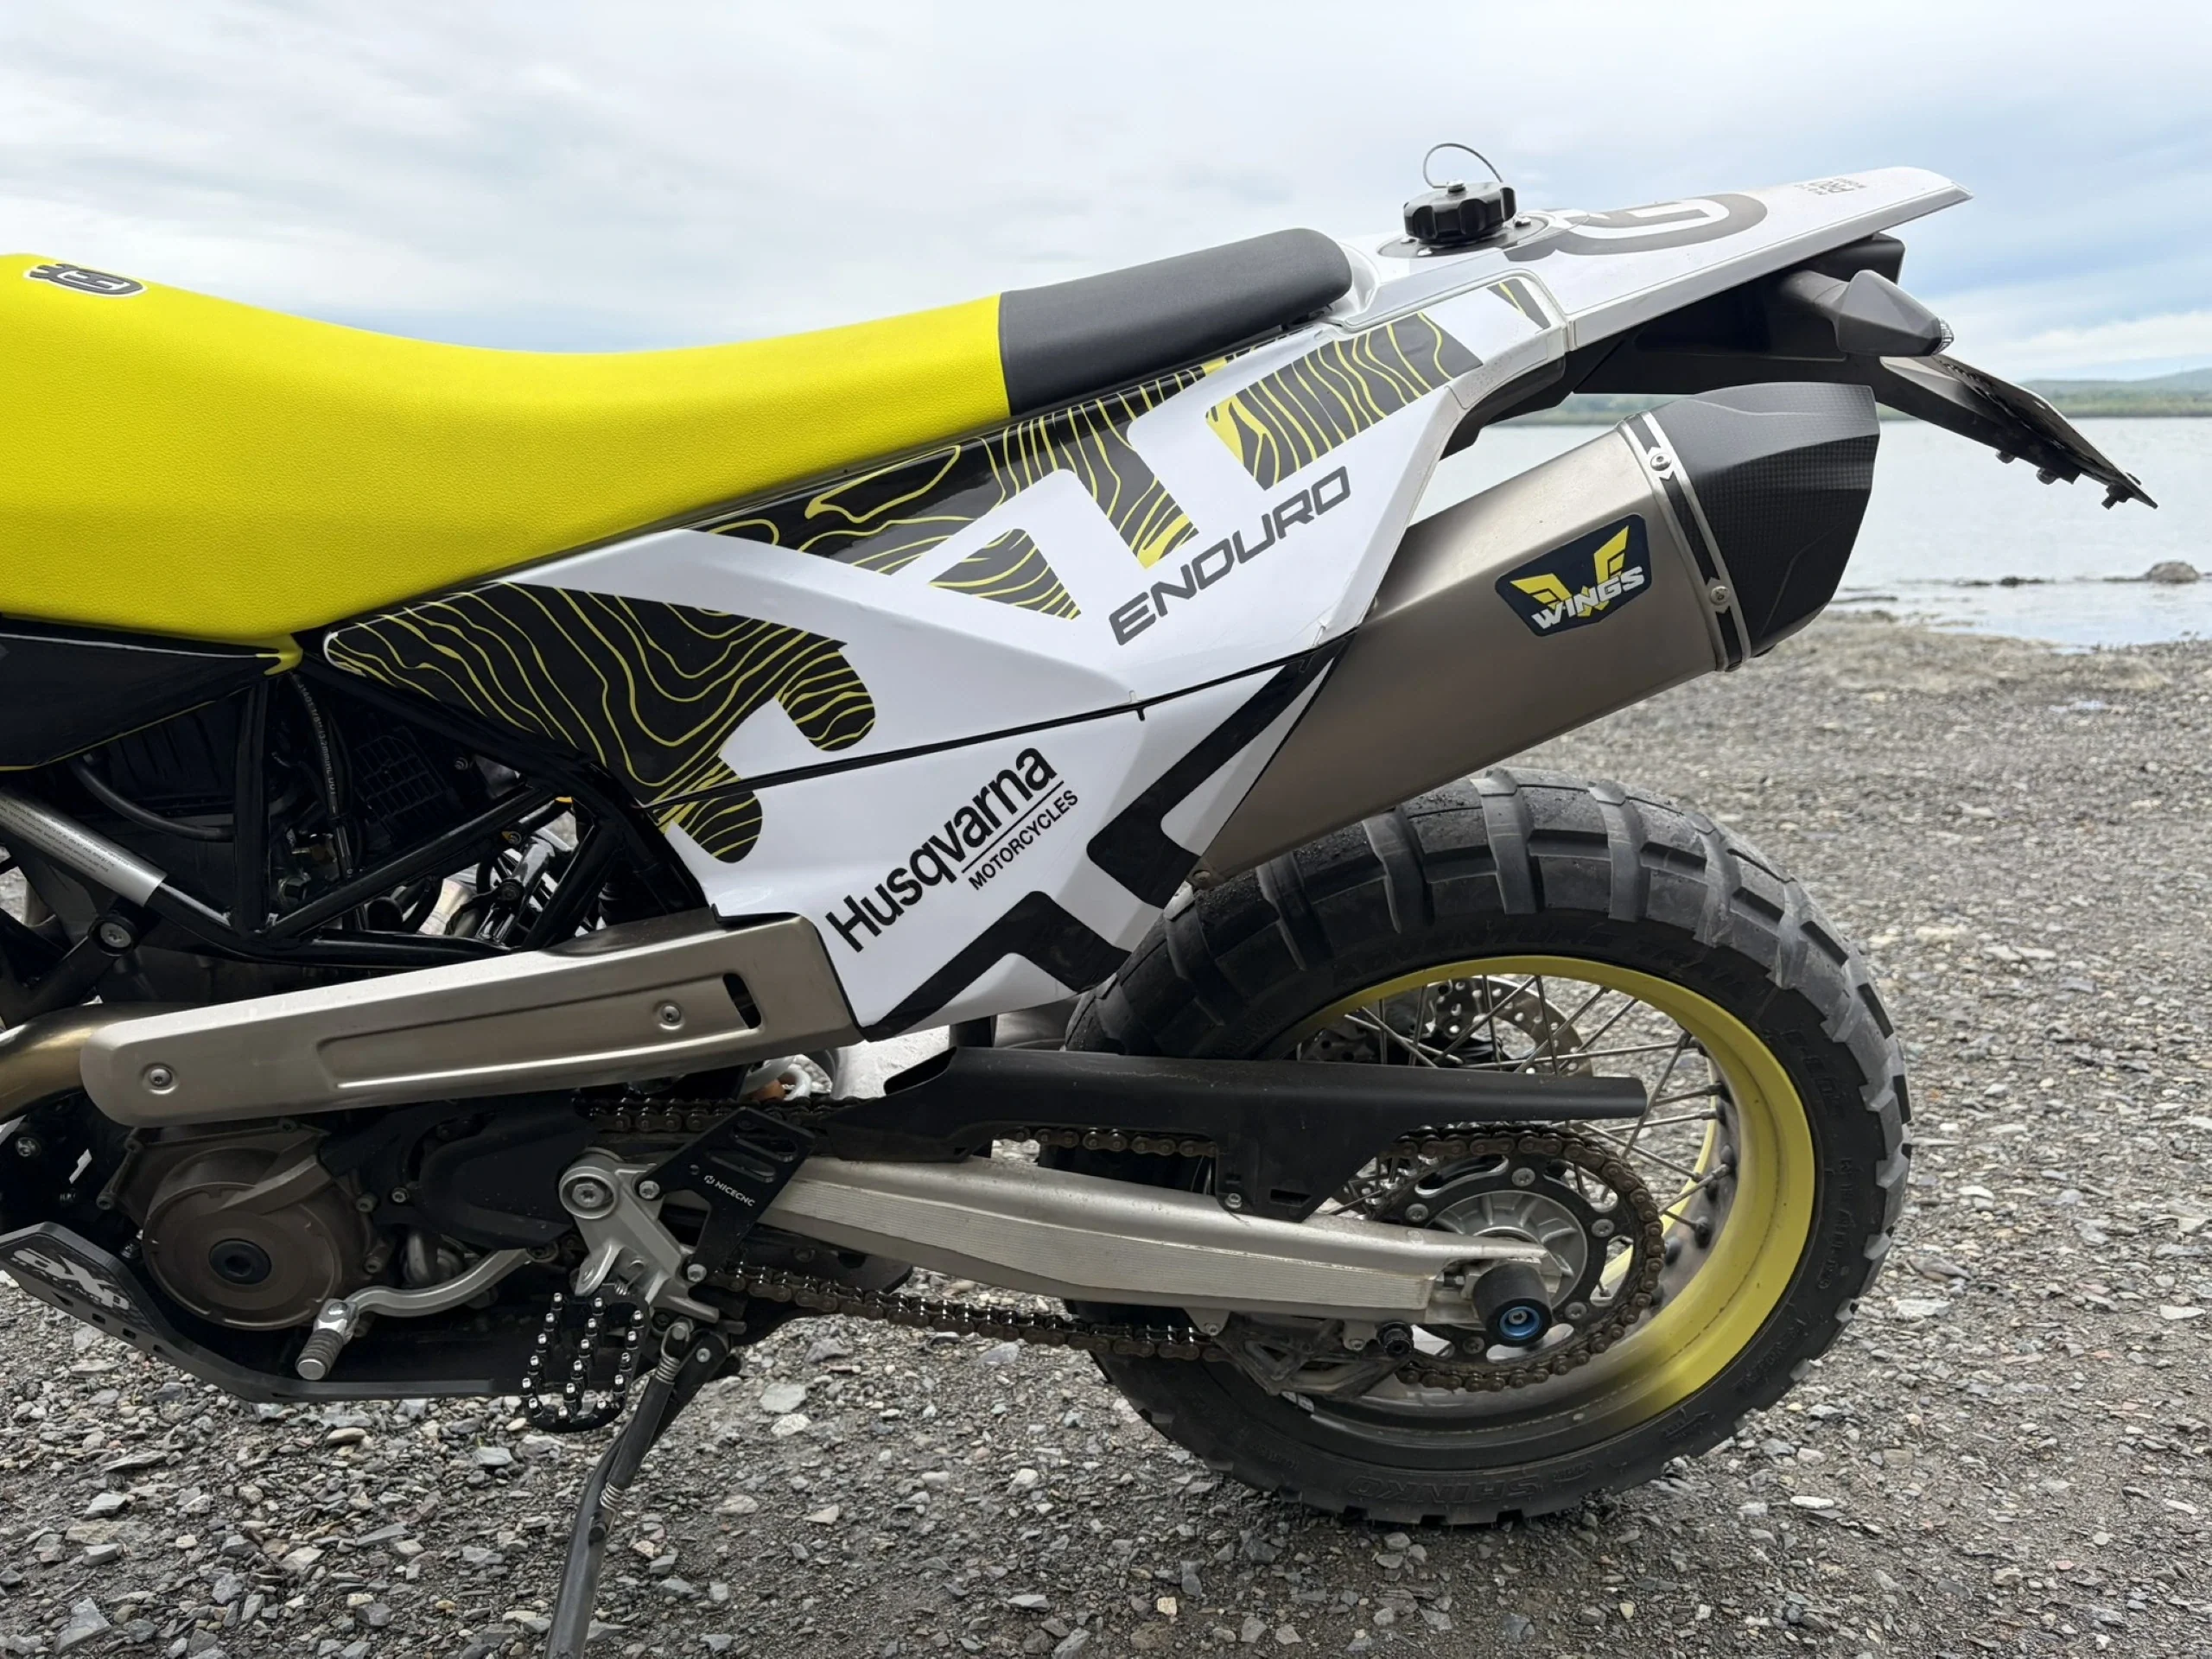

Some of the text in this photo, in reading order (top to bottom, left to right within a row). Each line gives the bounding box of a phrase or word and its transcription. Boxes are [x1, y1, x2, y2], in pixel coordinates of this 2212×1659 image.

[1109, 466, 1351, 645] ENDURO
[1531, 566, 1645, 630] WINGS
[825, 747, 1058, 953] Husqvarna
[969, 790, 1078, 891] MOTORCYCLES
[715, 1180, 756, 1207] NICECNC
[1346, 1476, 1540, 1503] SHINKO
